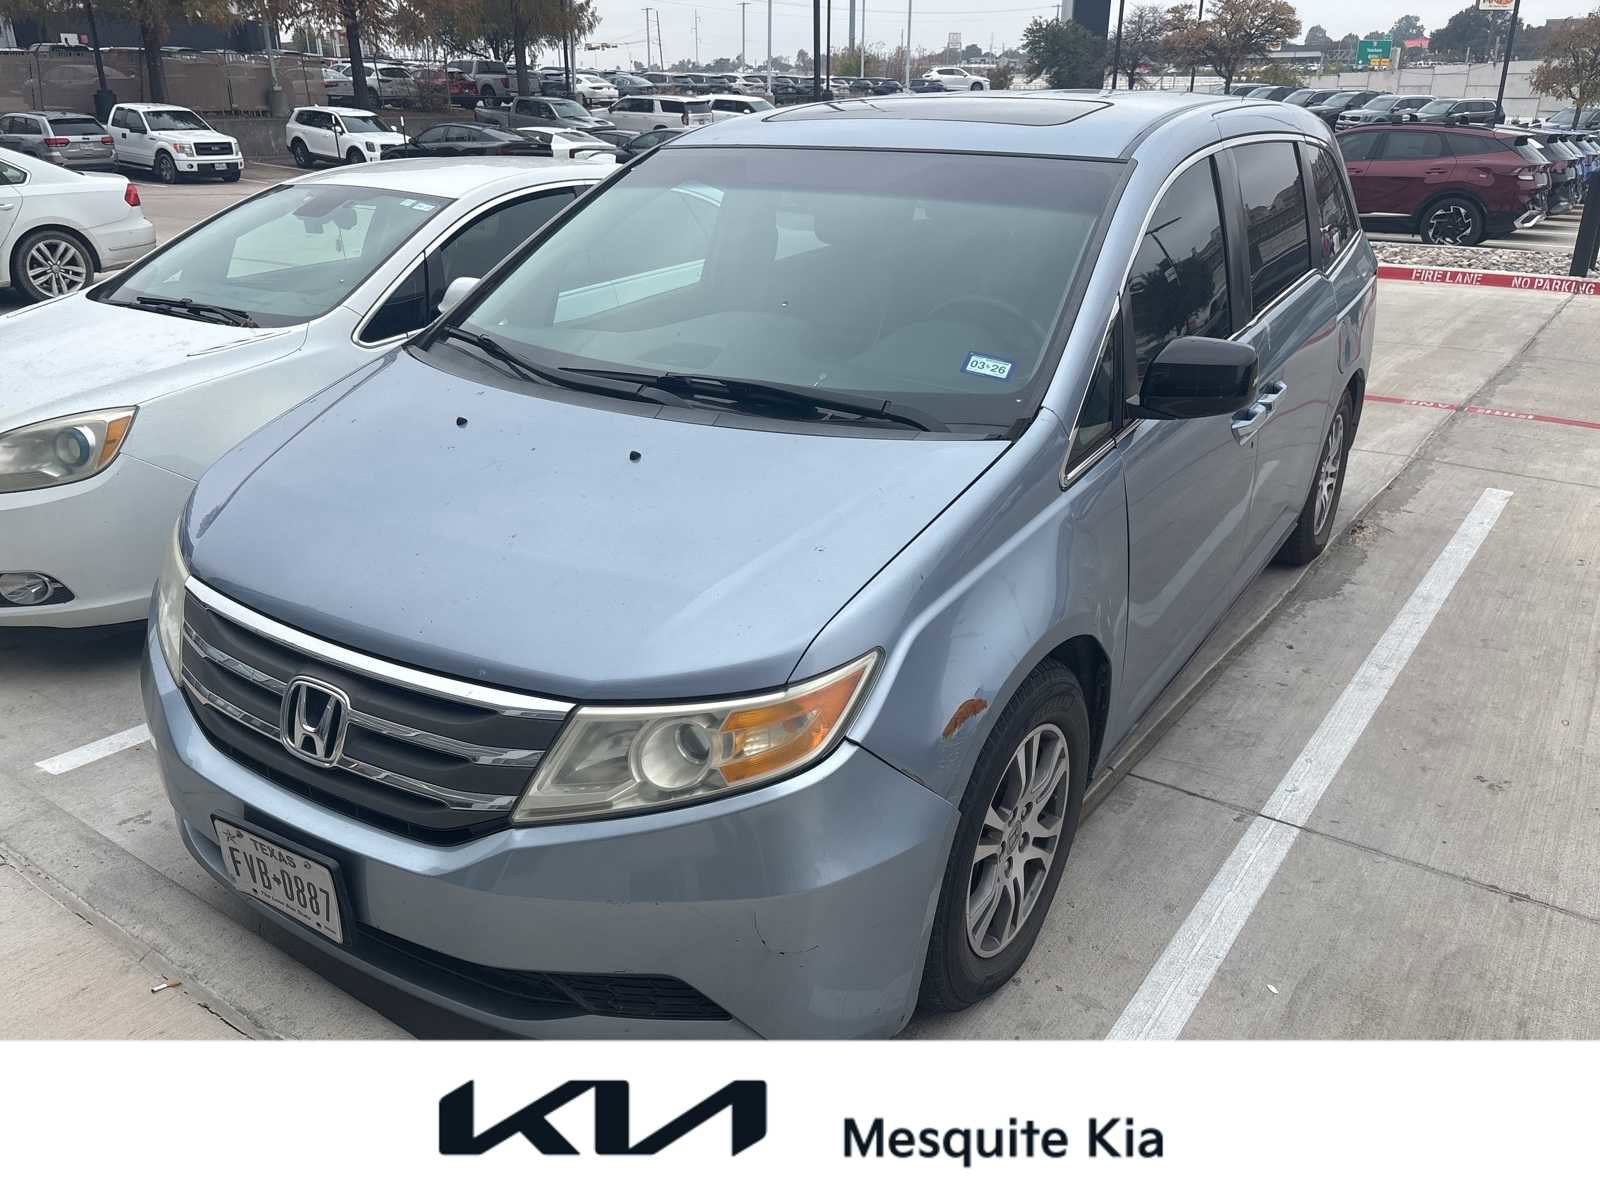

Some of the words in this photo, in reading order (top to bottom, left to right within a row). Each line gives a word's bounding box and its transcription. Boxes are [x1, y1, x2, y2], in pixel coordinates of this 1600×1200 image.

[1411, 269, 1443, 283] FIRE
[1445, 271, 1483, 286] LANE
[1512, 276, 1530, 289] NO
[1533, 278, 1596, 296] PARKING
[250, 838, 297, 869] TEXAS
